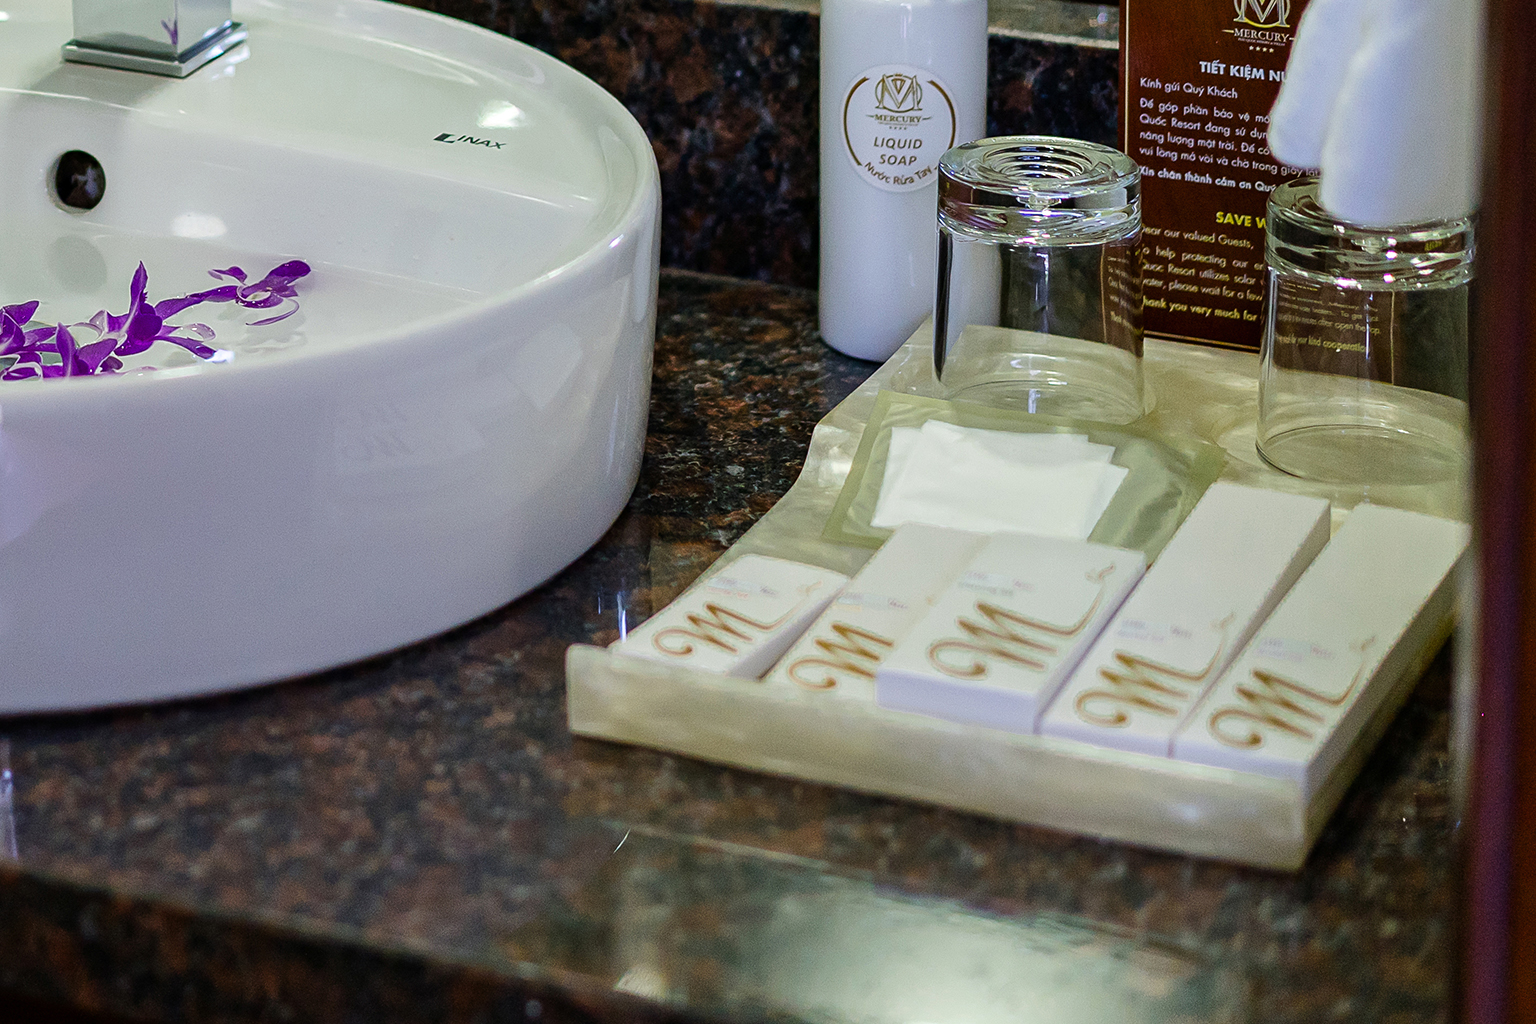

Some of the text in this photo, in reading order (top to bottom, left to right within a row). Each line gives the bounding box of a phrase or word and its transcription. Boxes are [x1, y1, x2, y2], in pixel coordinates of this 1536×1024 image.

[1234, 28, 1289, 42] MERCURY
[1199, 60, 1226, 75] TIẾT
[1230, 64, 1264, 81] KIỆM
[1140, 77, 1162, 90] Kính
[1183, 82, 1205, 97] Quý
[1207, 86, 1238, 99] Khách
[1158, 101, 1179, 114] góp
[875, 114, 922, 123] MERCURY
[1171, 118, 1201, 130] Resort
[1205, 122, 1231, 137] đang
[457, 135, 506, 149] INAX
[873, 136, 923, 150] LIQUID
[879, 154, 917, 166] SOAP
[1253, 161, 1278, 175] trong
[915, 166, 933, 181] Tay
[1215, 211, 1252, 227] SAVE
[1164, 229, 1181, 238] our
[1183, 230, 1216, 244] valued
[1218, 234, 1254, 250] Guests,
[1155, 245, 1176, 260] help
[1181, 251, 1227, 268] protecting
[1232, 259, 1249, 268] our
[1167, 263, 1195, 276] Resort
[1233, 273, 1256, 285] solar
[1168, 279, 1199, 293] please
[1200, 285, 1221, 296] wait
[1222, 285, 1236, 298] for
[1236, 291, 1244, 300] a
[1169, 301, 1188, 313] you
[1189, 304, 1212, 317] very
[1214, 308, 1241, 320] much
[1242, 309, 1258, 322] for
